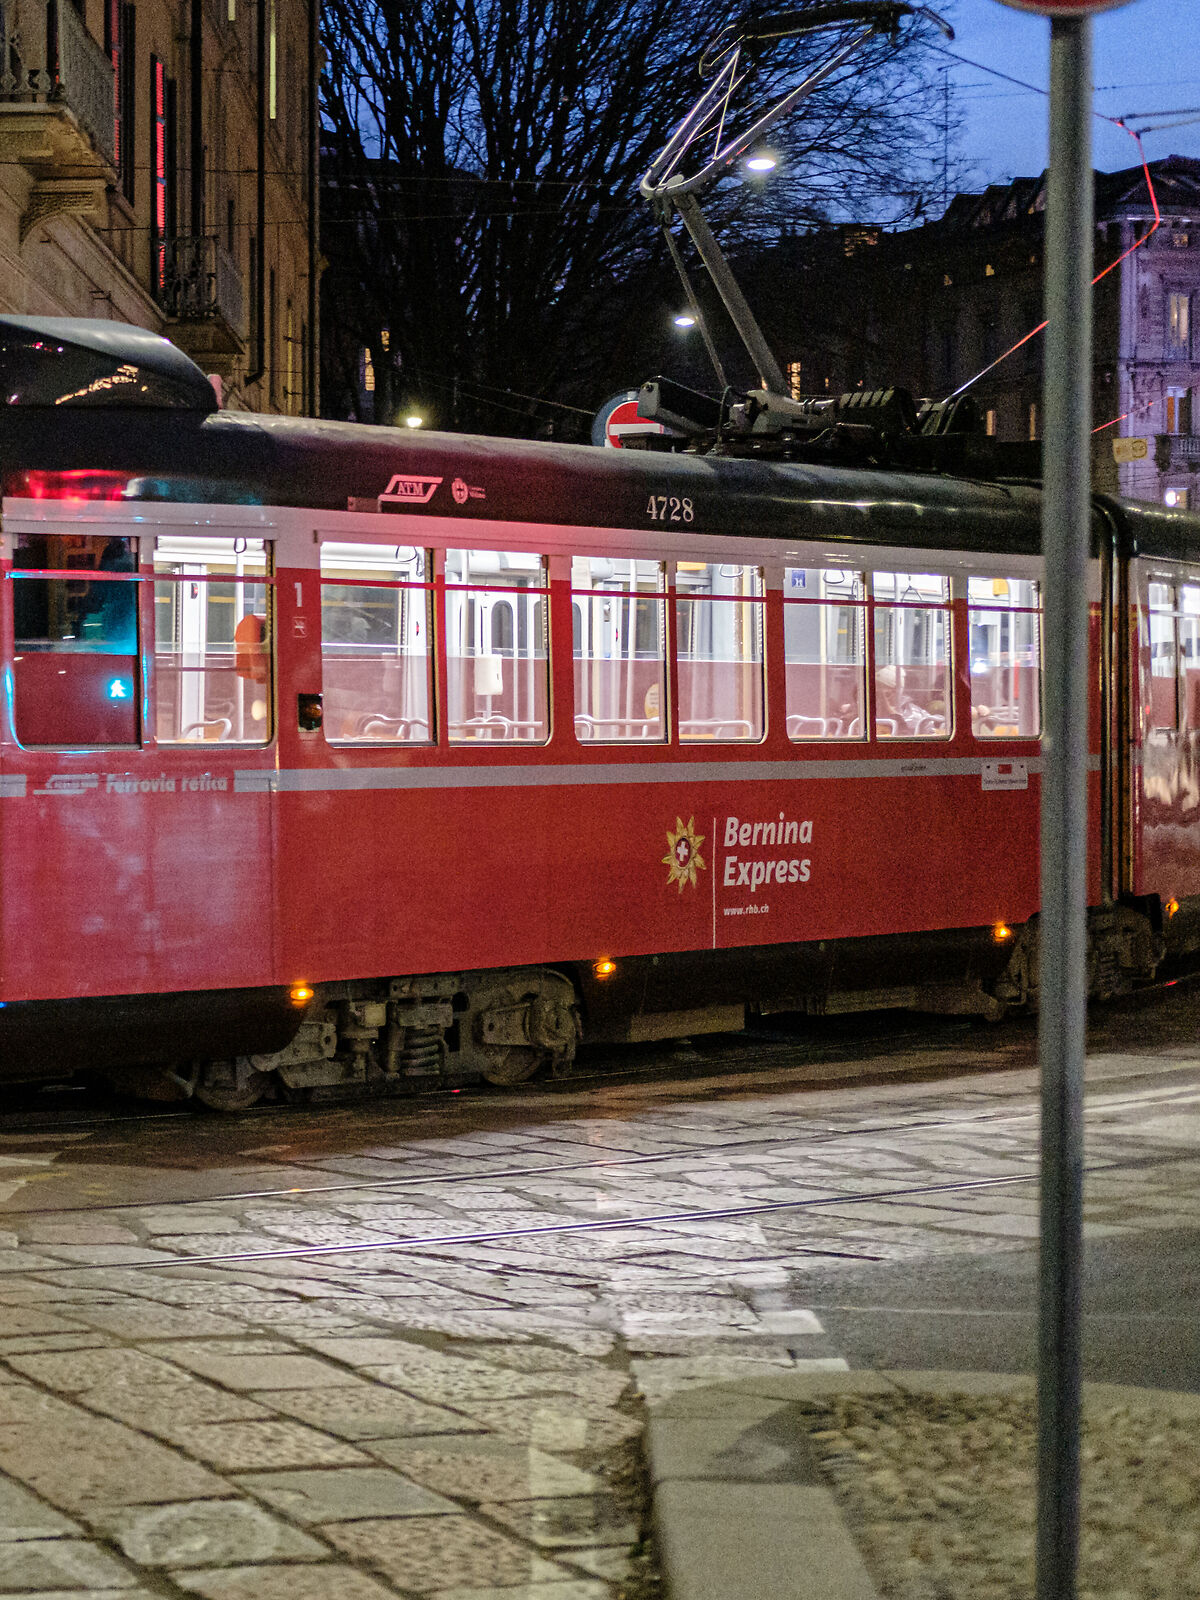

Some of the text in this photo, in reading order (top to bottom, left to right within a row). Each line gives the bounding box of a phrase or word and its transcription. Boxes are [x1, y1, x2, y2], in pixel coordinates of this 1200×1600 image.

[397, 482, 425, 497] ATM
[646, 495, 694, 522] 4728
[294, 582, 303, 607] 1
[106, 772, 176, 793] Ferrovia
[723, 811, 813, 847] Bernina
[723, 855, 812, 893] Express
[723, 903, 770, 916] www.rhb.ch
